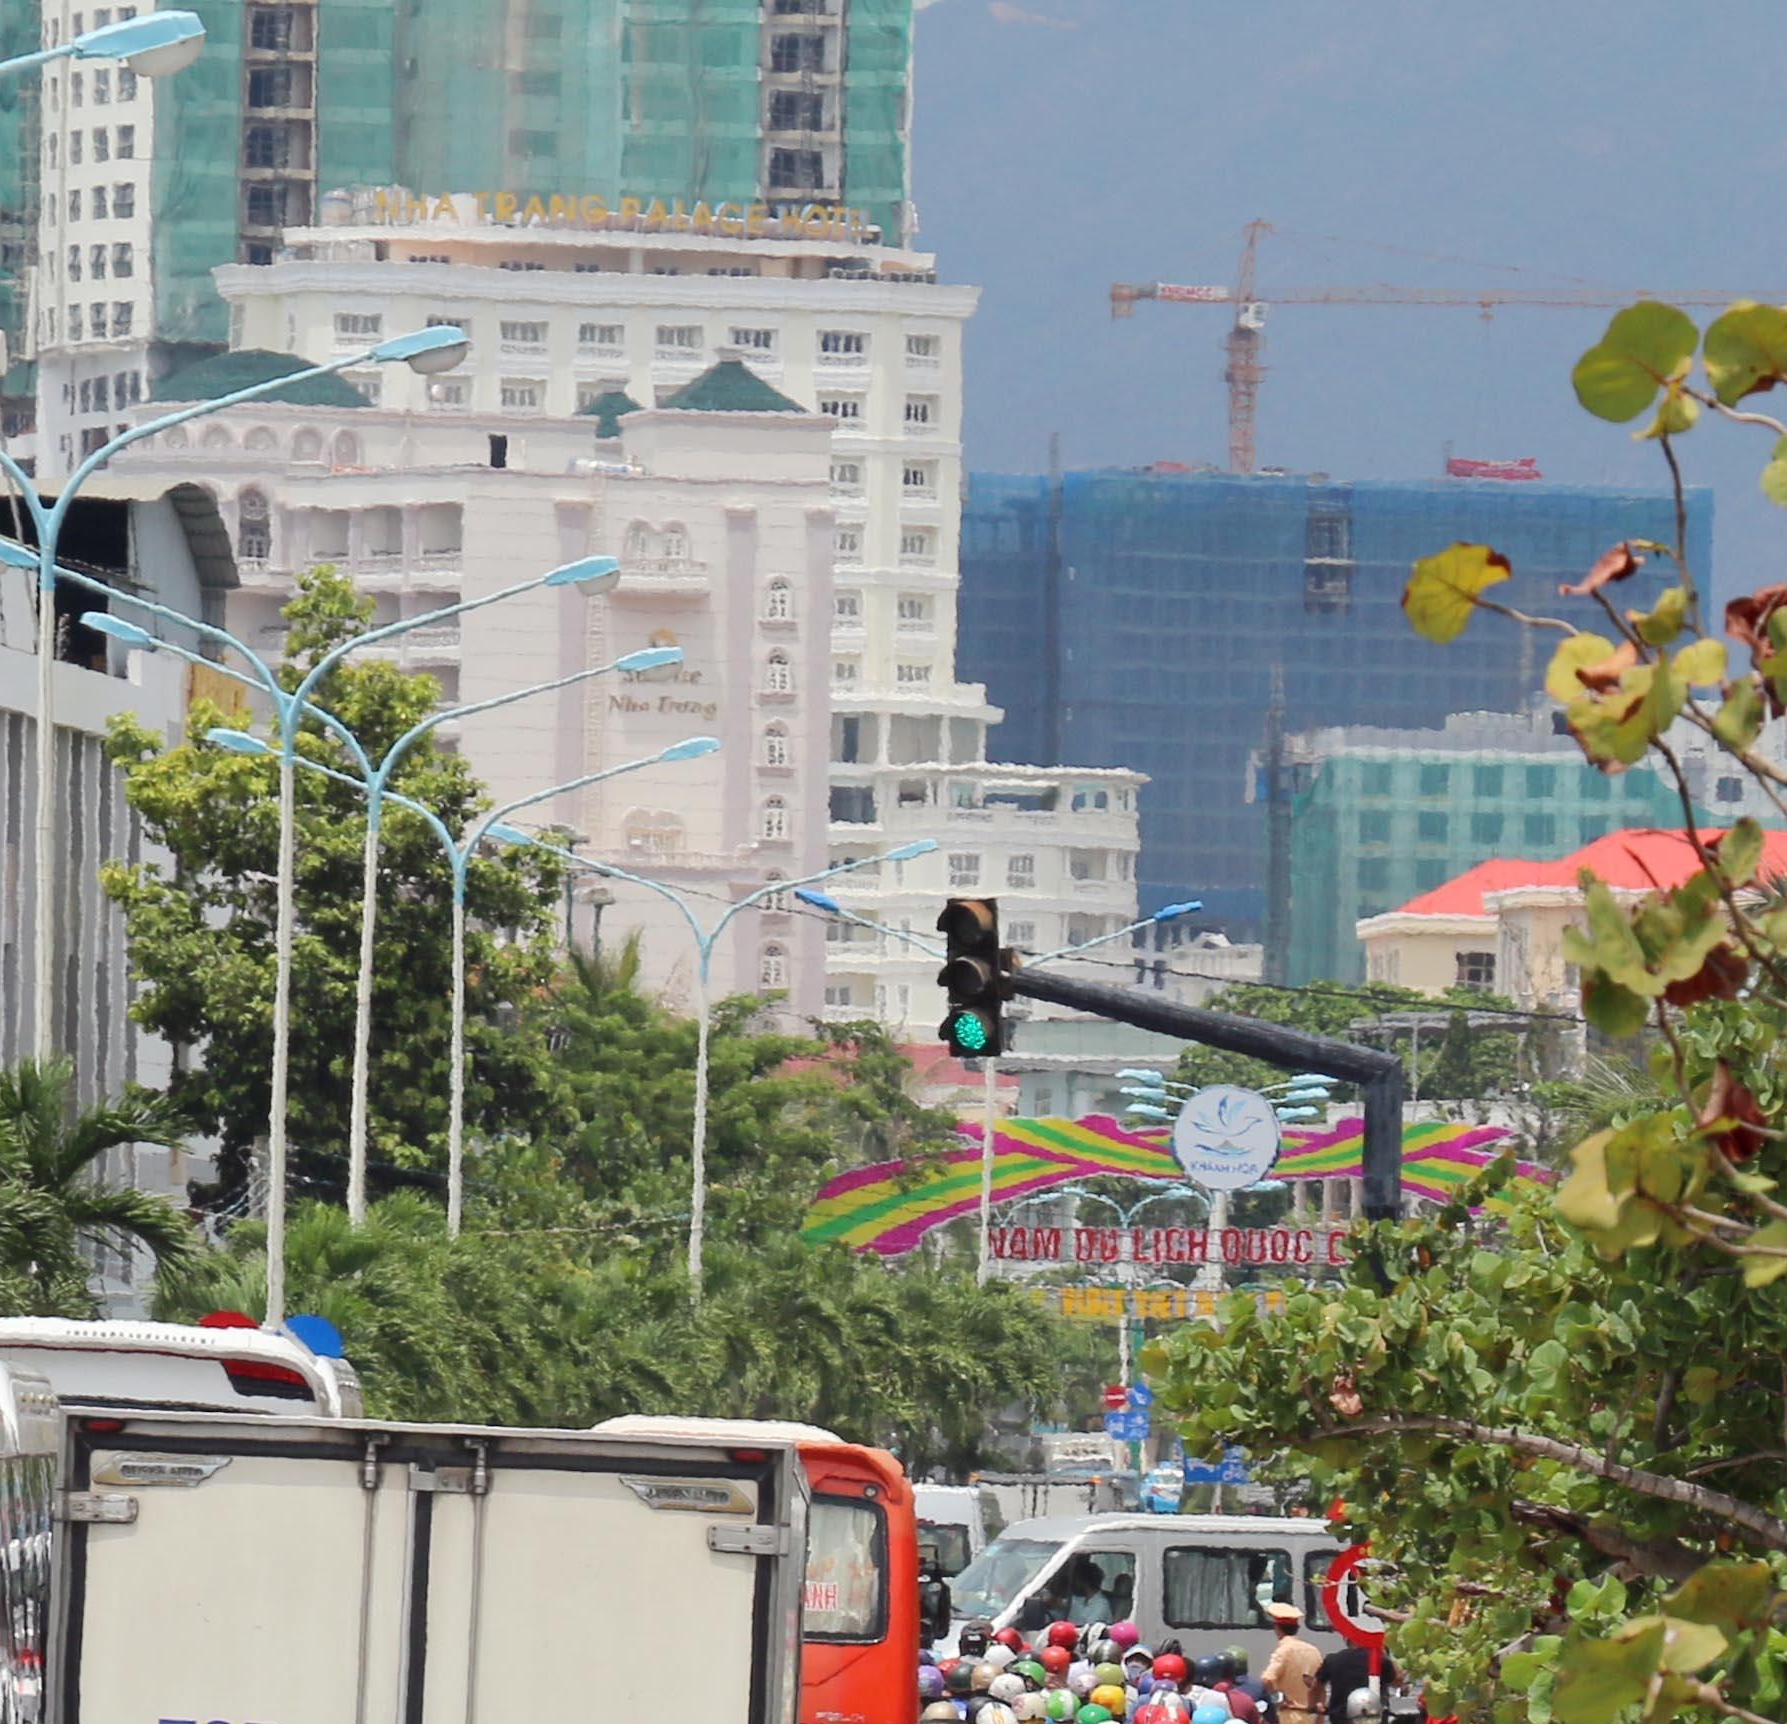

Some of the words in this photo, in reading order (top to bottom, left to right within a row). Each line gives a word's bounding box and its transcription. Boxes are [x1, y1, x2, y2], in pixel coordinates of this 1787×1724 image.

[376, 192, 460, 221] NHA
[470, 192, 609, 224] TRANG
[620, 197, 768, 236] PALACE
[780, 204, 875, 241] HOTEL
